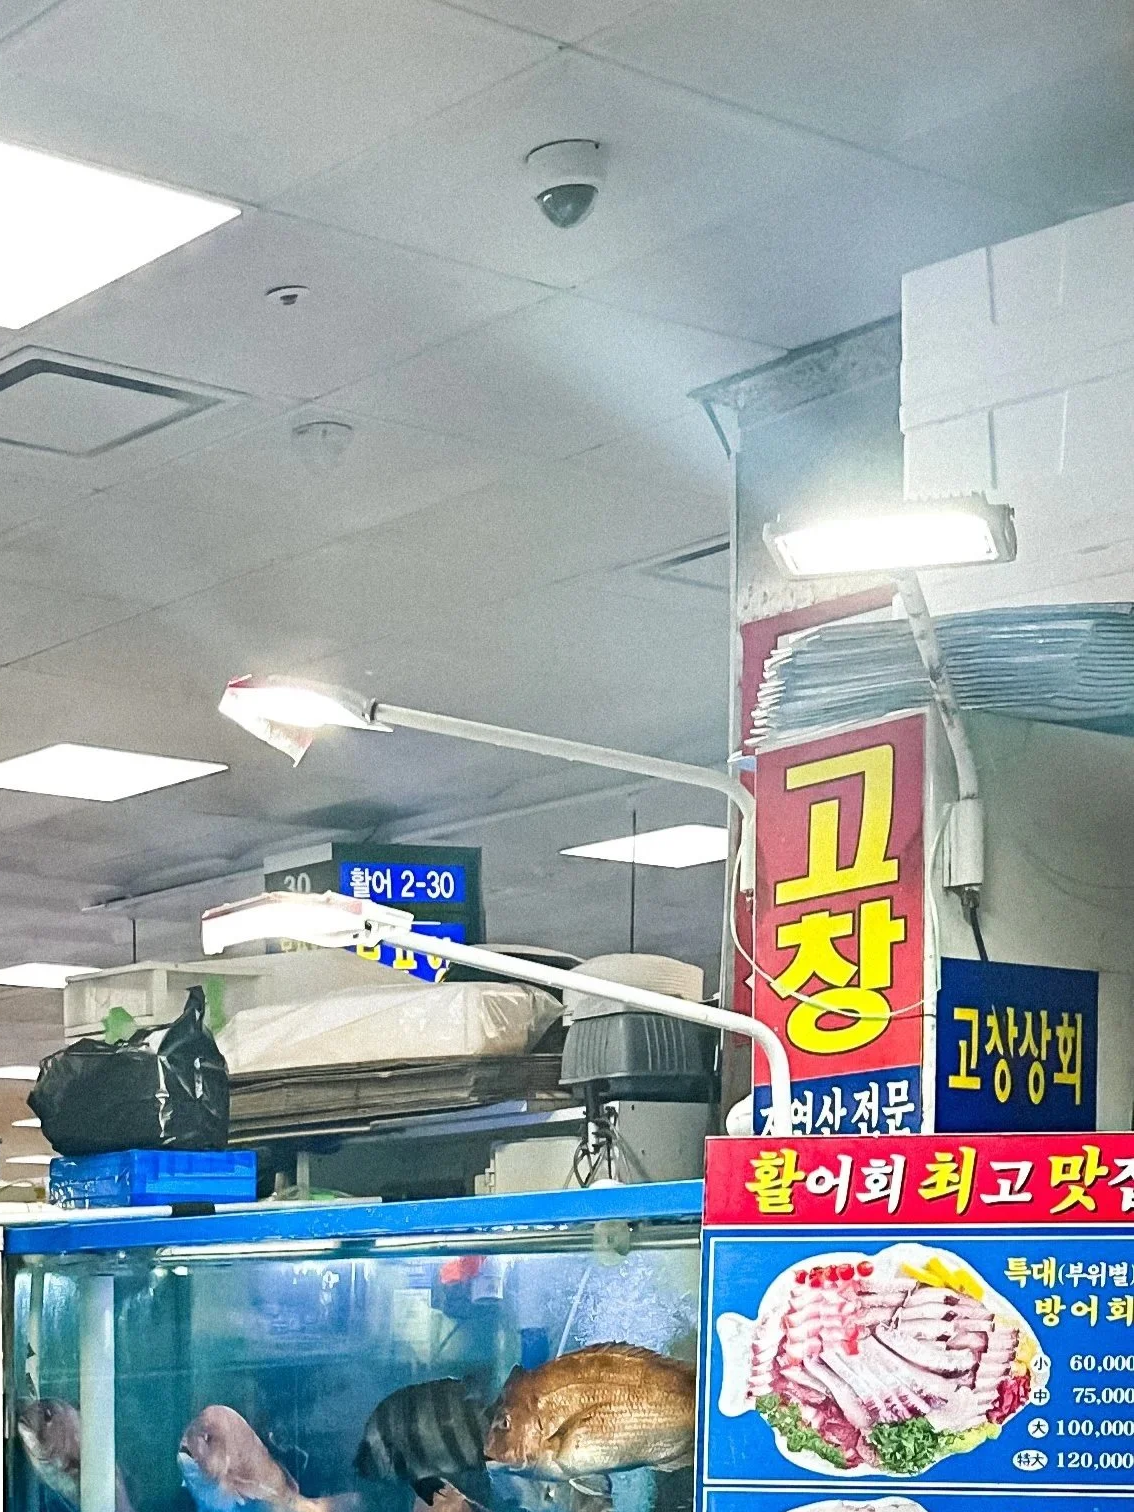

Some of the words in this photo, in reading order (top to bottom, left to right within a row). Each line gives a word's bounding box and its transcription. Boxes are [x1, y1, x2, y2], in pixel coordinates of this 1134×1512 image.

[350, 867, 392, 898] 활어
[401, 870, 454, 898] 2-30
[775, 742, 907, 1056] 고창
[949, 1007, 1083, 1106] 고창상회
[745, 1148, 907, 1214] 활어회
[919, 1146, 1034, 1214] 최고
[1032, 1355, 1049, 1372] 小
[1070, 1355, 1134, 1373] 60,000
[1032, 1388, 1049, 1404] 中
[1073, 1388, 1134, 1405] 75,000
[1030, 1419, 1047, 1436] 大
[1057, 1420, 1134, 1437] 100,000
[1057, 1453, 1134, 1470] 120,000
